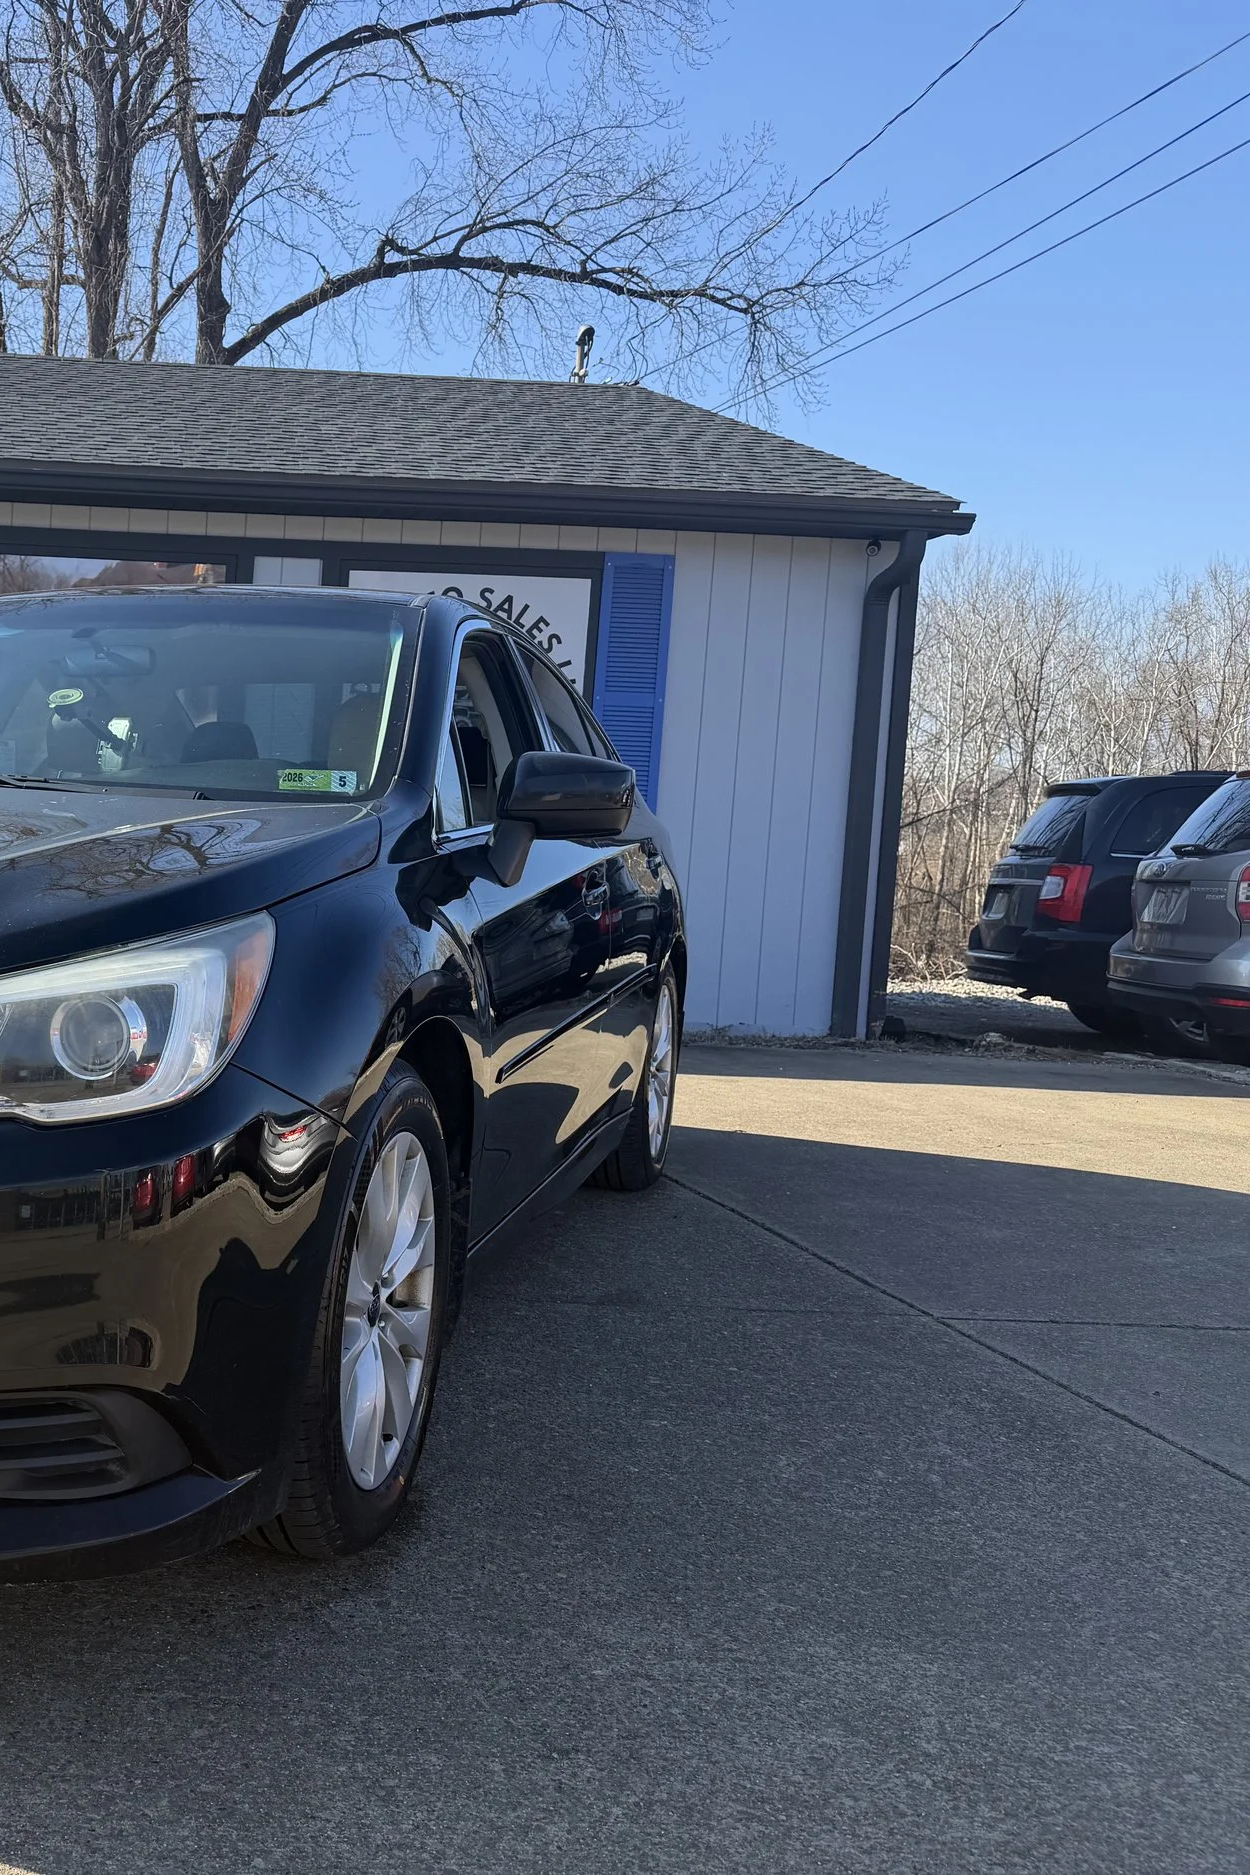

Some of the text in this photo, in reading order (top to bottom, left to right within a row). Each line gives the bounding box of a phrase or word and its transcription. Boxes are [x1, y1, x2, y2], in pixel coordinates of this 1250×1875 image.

[479, 587, 563, 655] SALES
[282, 772, 347, 788] 2026 5
